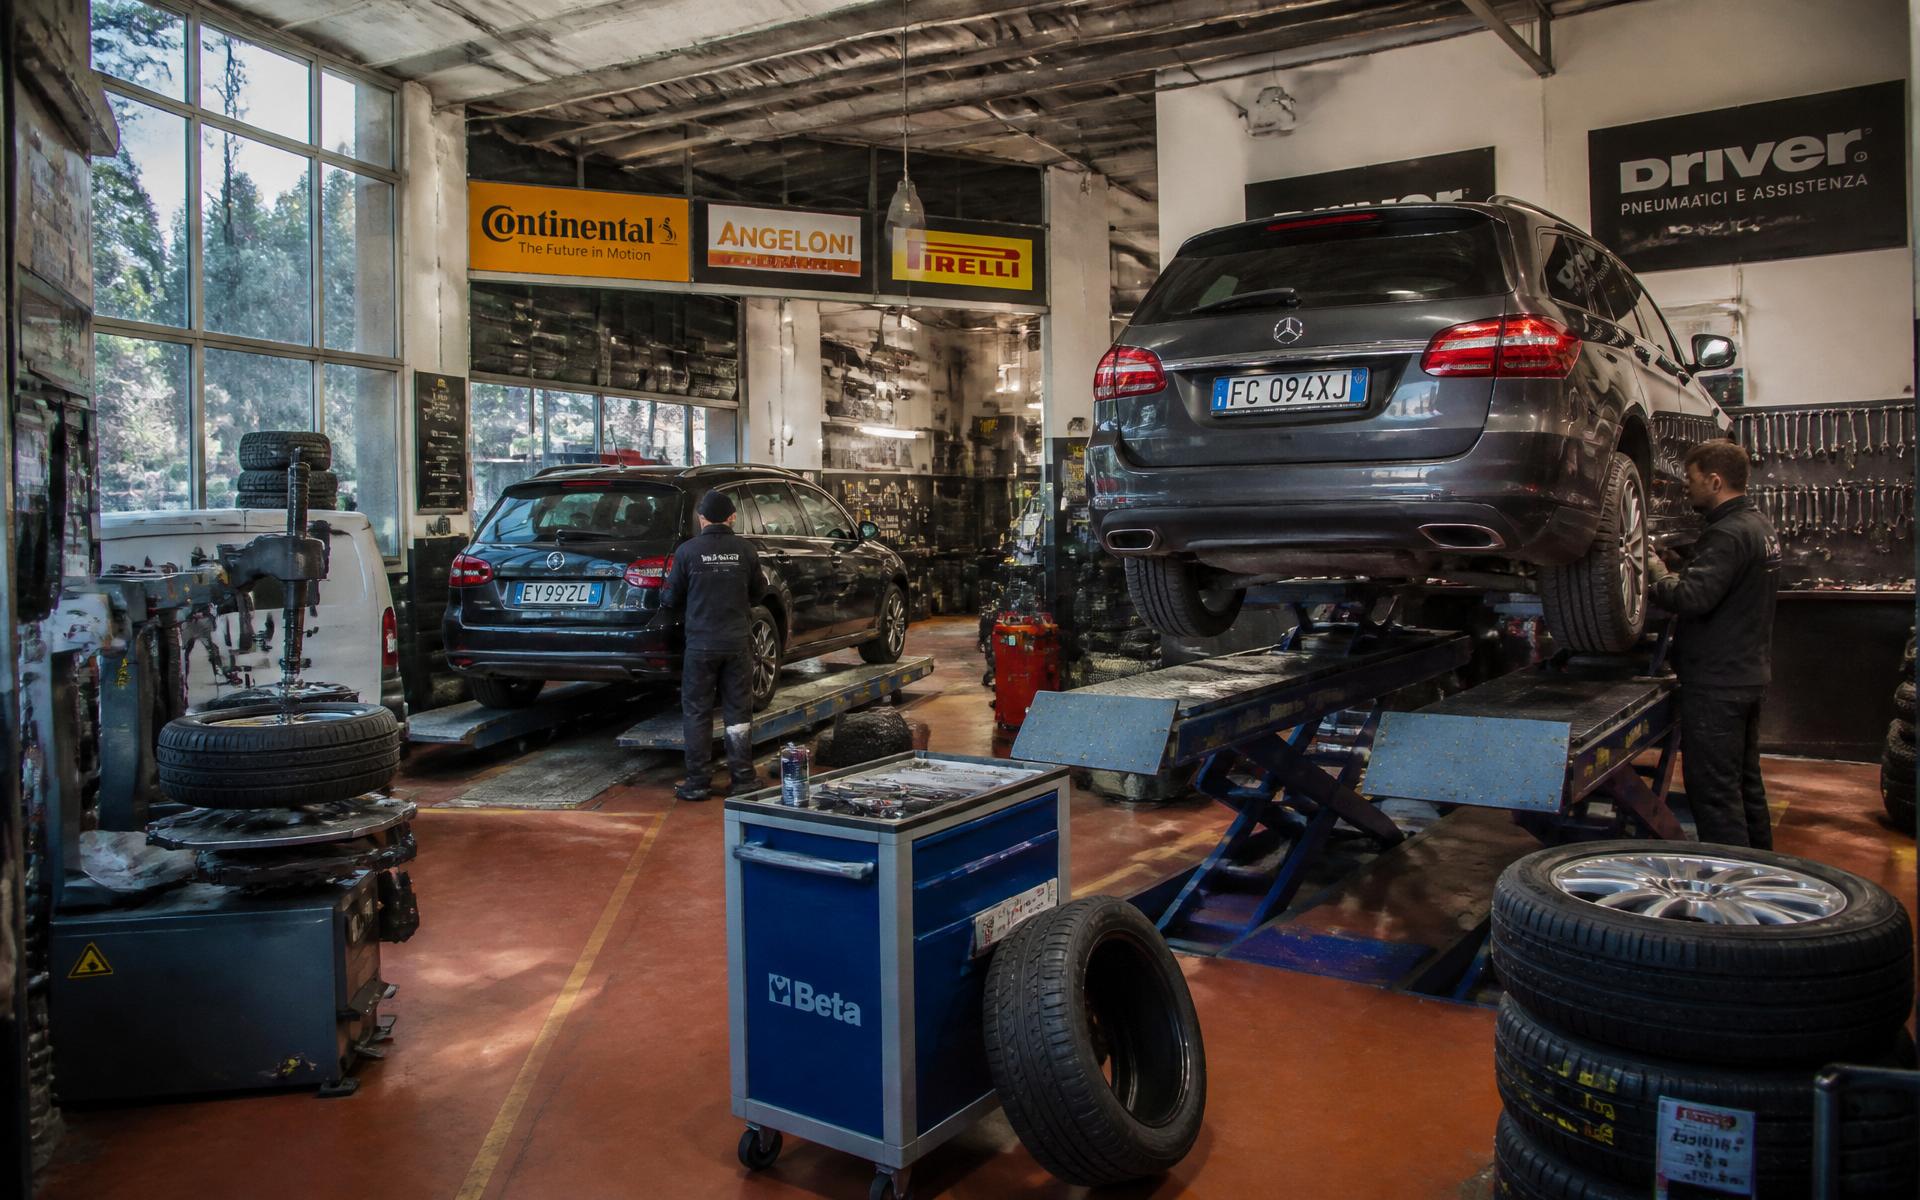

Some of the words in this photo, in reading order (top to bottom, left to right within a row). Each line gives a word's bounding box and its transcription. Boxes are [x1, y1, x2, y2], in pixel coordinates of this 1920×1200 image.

[1736, 188, 1747, 202] E
[1753, 173, 1869, 200] ASSISTENZA
[482, 205, 654, 243] Continental
[717, 221, 854, 255] ANGELONI
[519, 242, 543, 255] The
[547, 243, 588, 257] Future
[592, 246, 603, 258] in
[607, 247, 651, 261] Motion
[907, 239, 1021, 278] PIRELLI
[1230, 380, 1260, 406] FC
[523, 585, 542, 602] EY
[794, 980, 861, 1027] Beta
